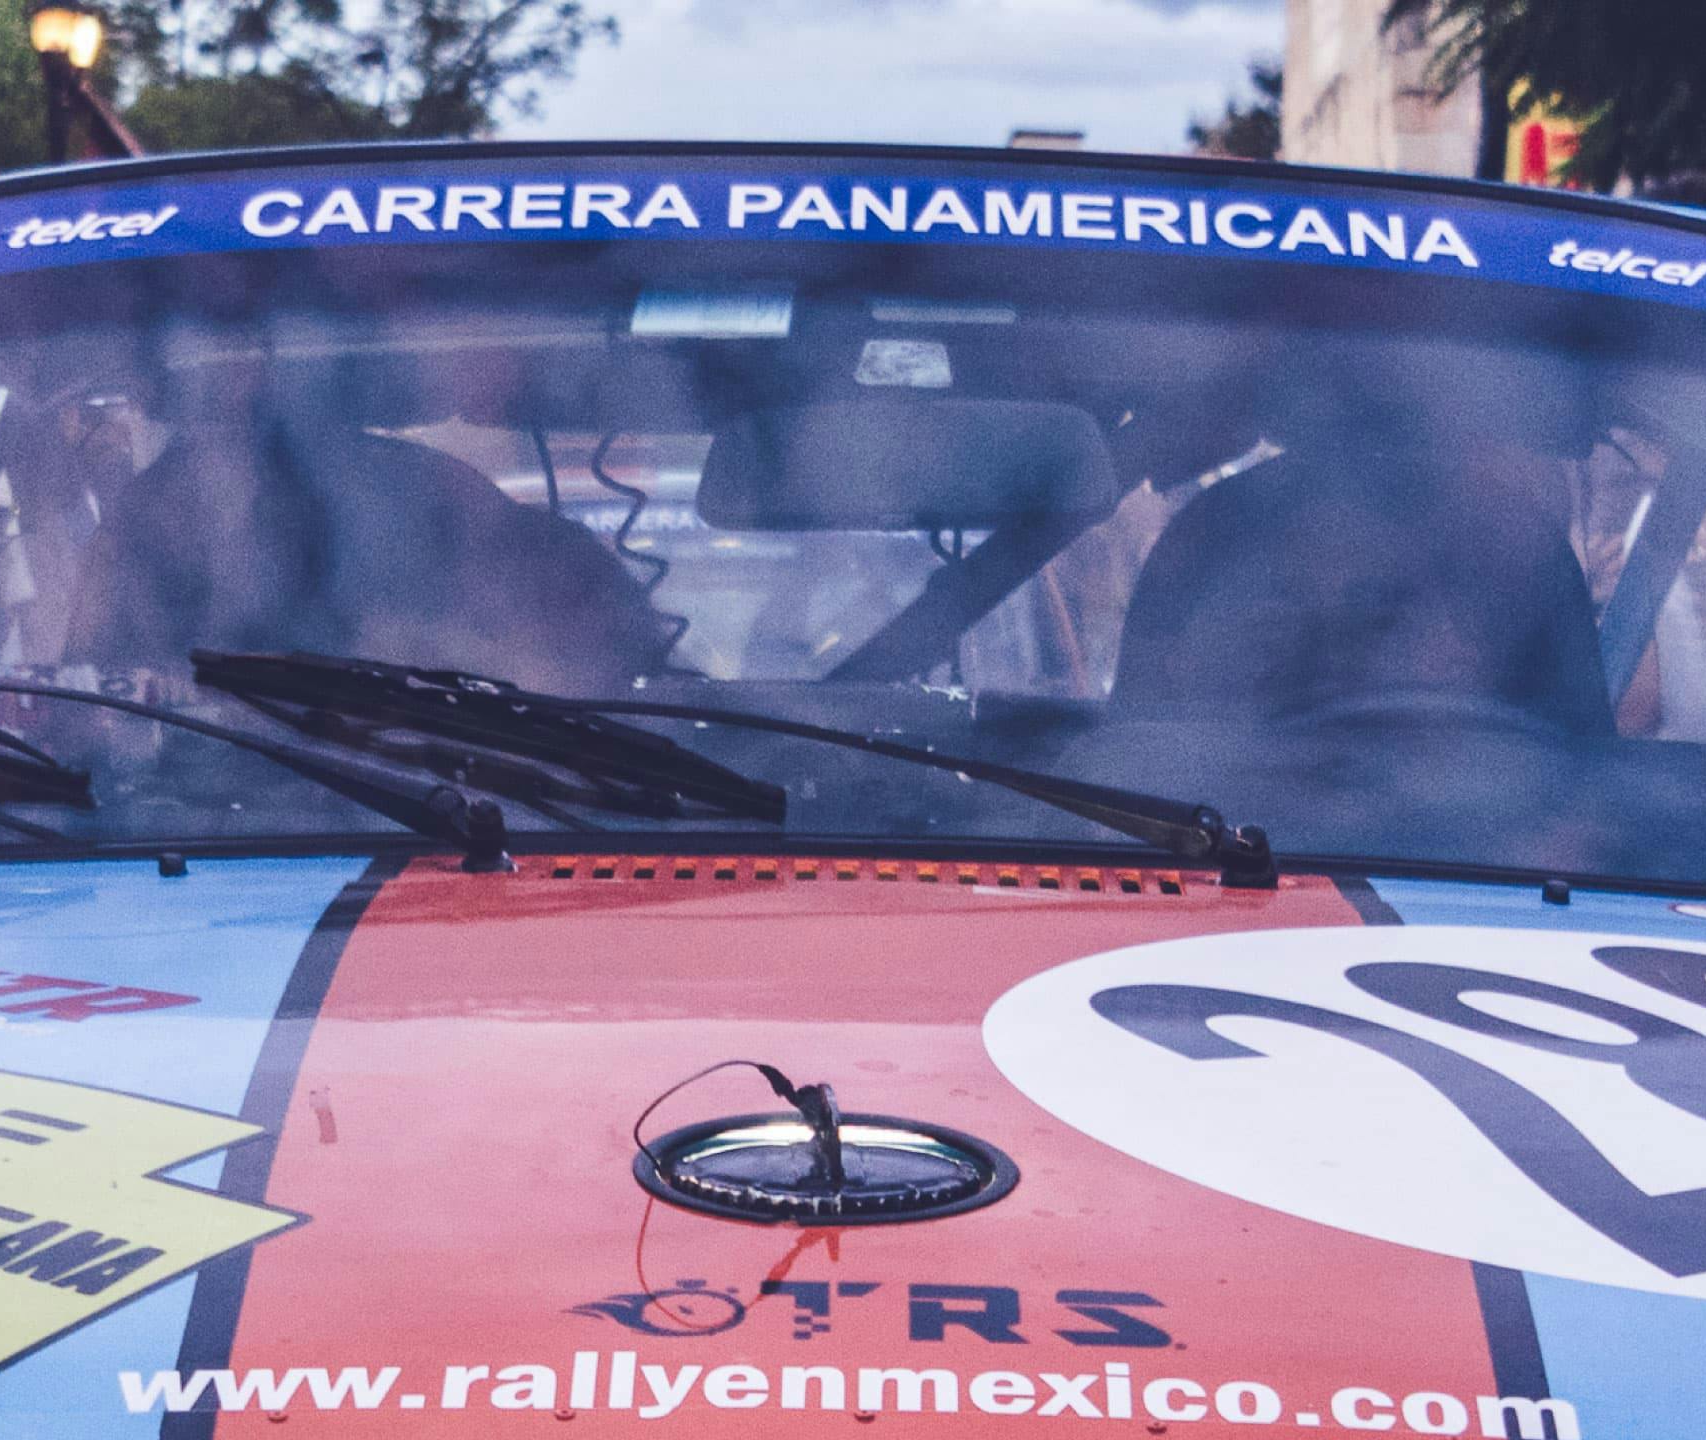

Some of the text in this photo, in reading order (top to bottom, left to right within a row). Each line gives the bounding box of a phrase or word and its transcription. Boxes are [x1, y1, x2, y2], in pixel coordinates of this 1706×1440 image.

[5, 204, 180, 251] telcel
[241, 182, 1480, 268] CARRERA PANAMERICANA
[759, 1280, 1174, 1348] TRS
